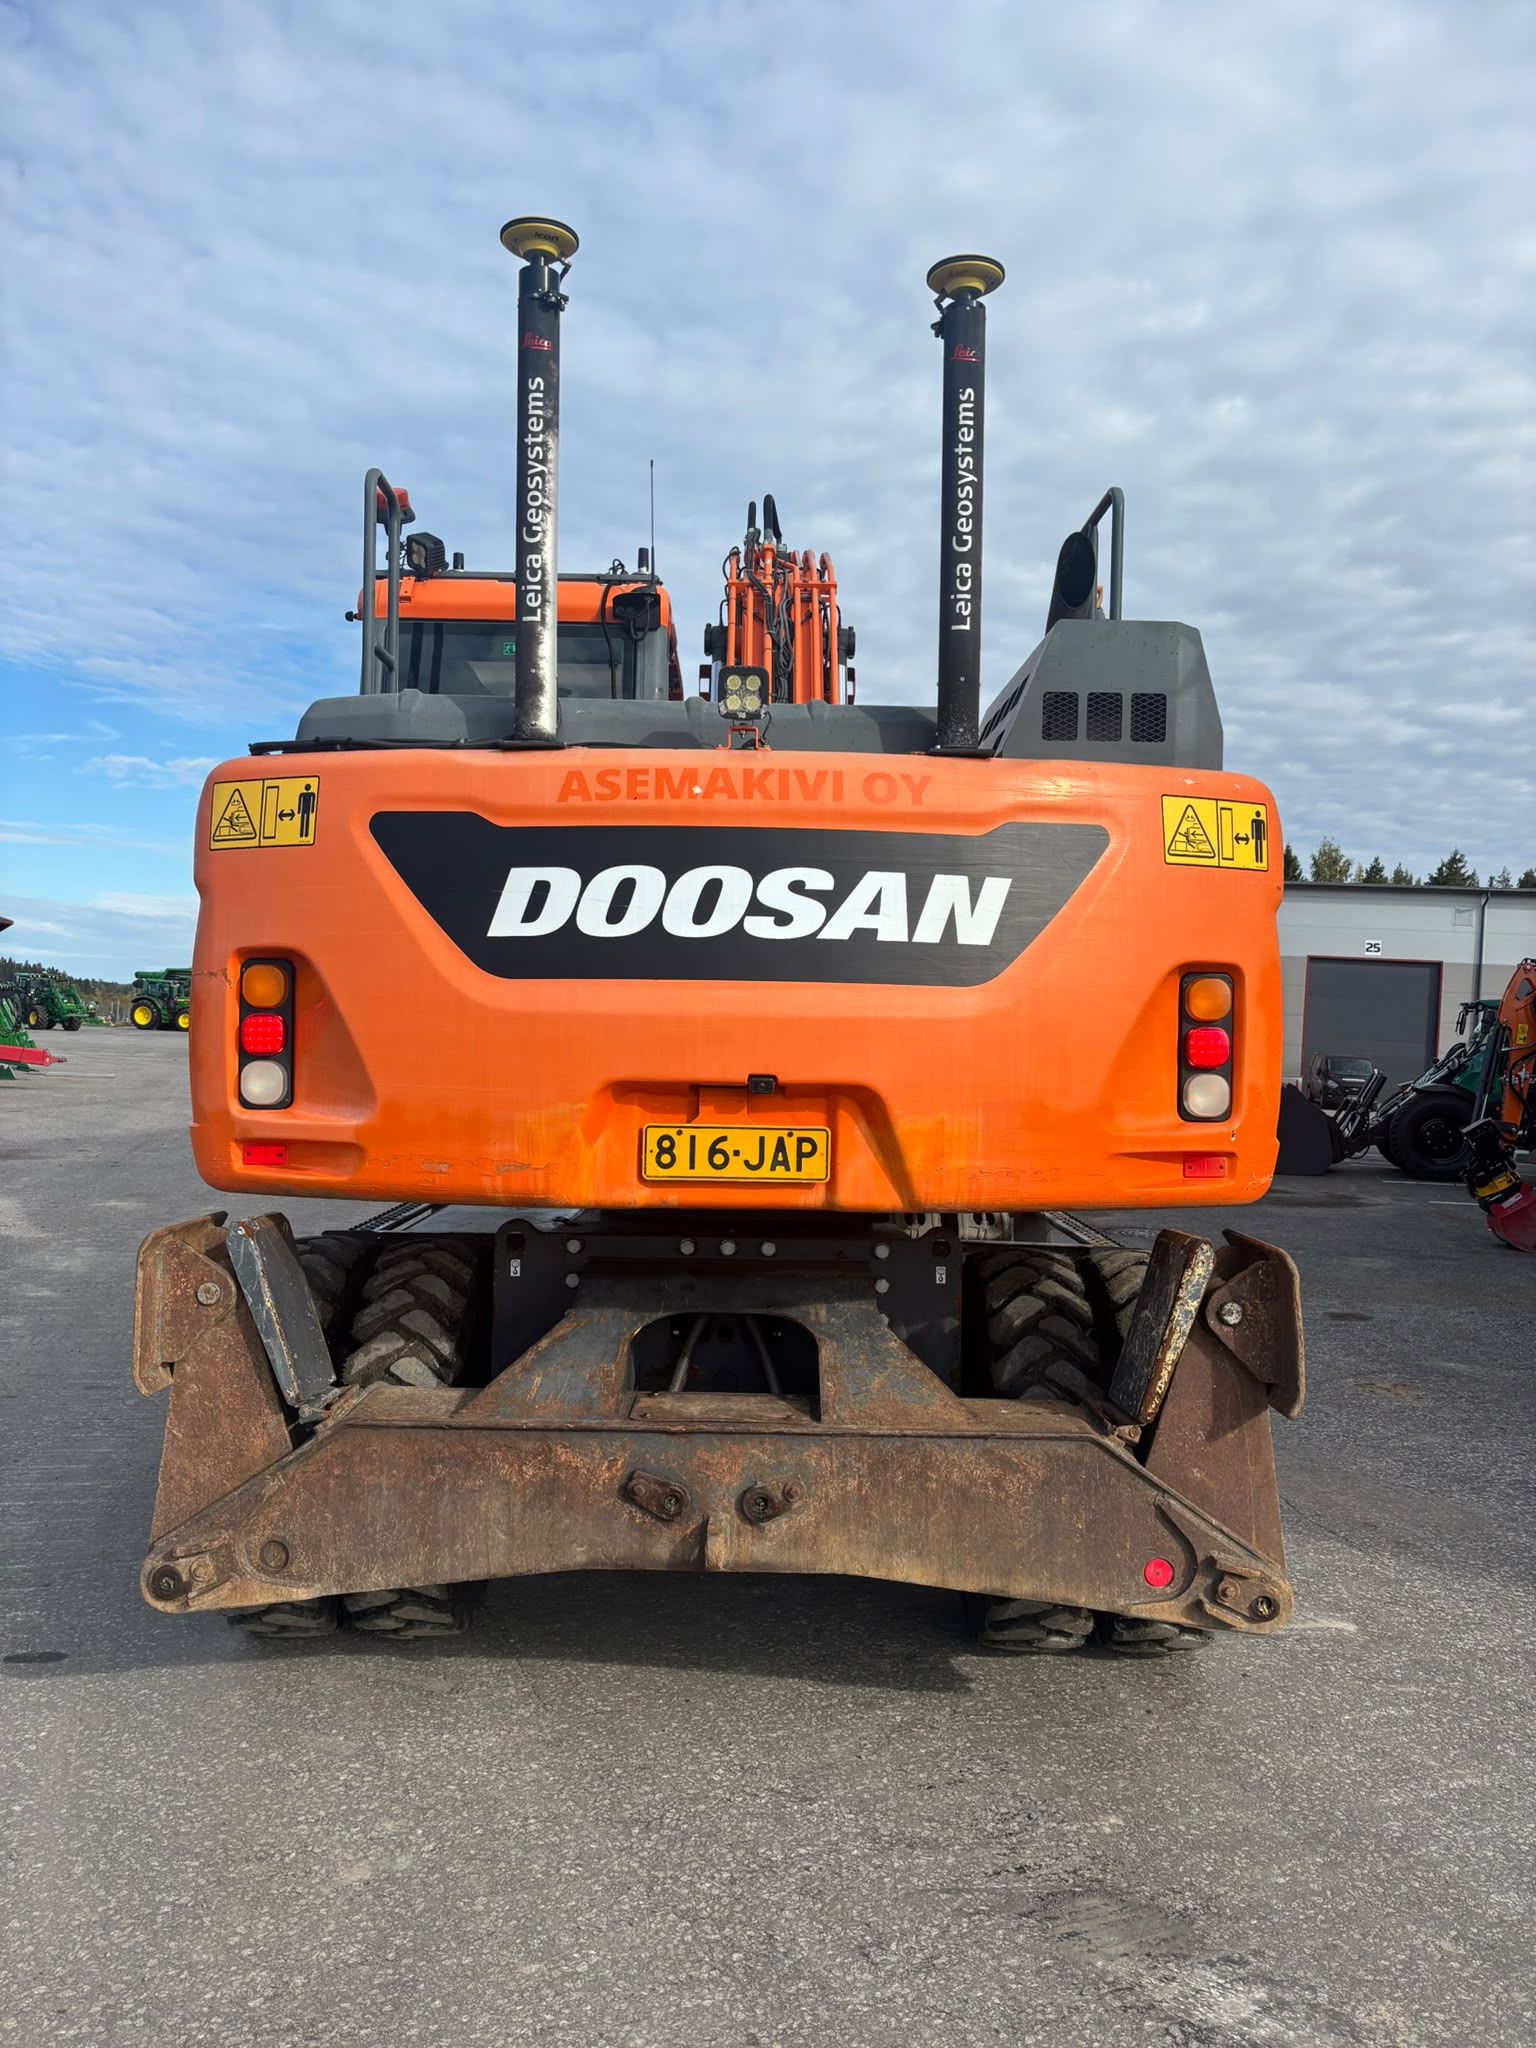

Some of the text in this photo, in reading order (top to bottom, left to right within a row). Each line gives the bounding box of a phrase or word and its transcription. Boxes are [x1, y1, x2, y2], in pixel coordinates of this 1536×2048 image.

[521, 376, 547, 622] Leica Geosystems
[950, 387, 978, 631] Leica Geosystems
[556, 766, 933, 807] ASEMAKIVI OY
[486, 864, 1012, 945] DOOSAN
[1365, 942, 1381, 953] 25
[655, 1134, 818, 1172] 816-JAP
